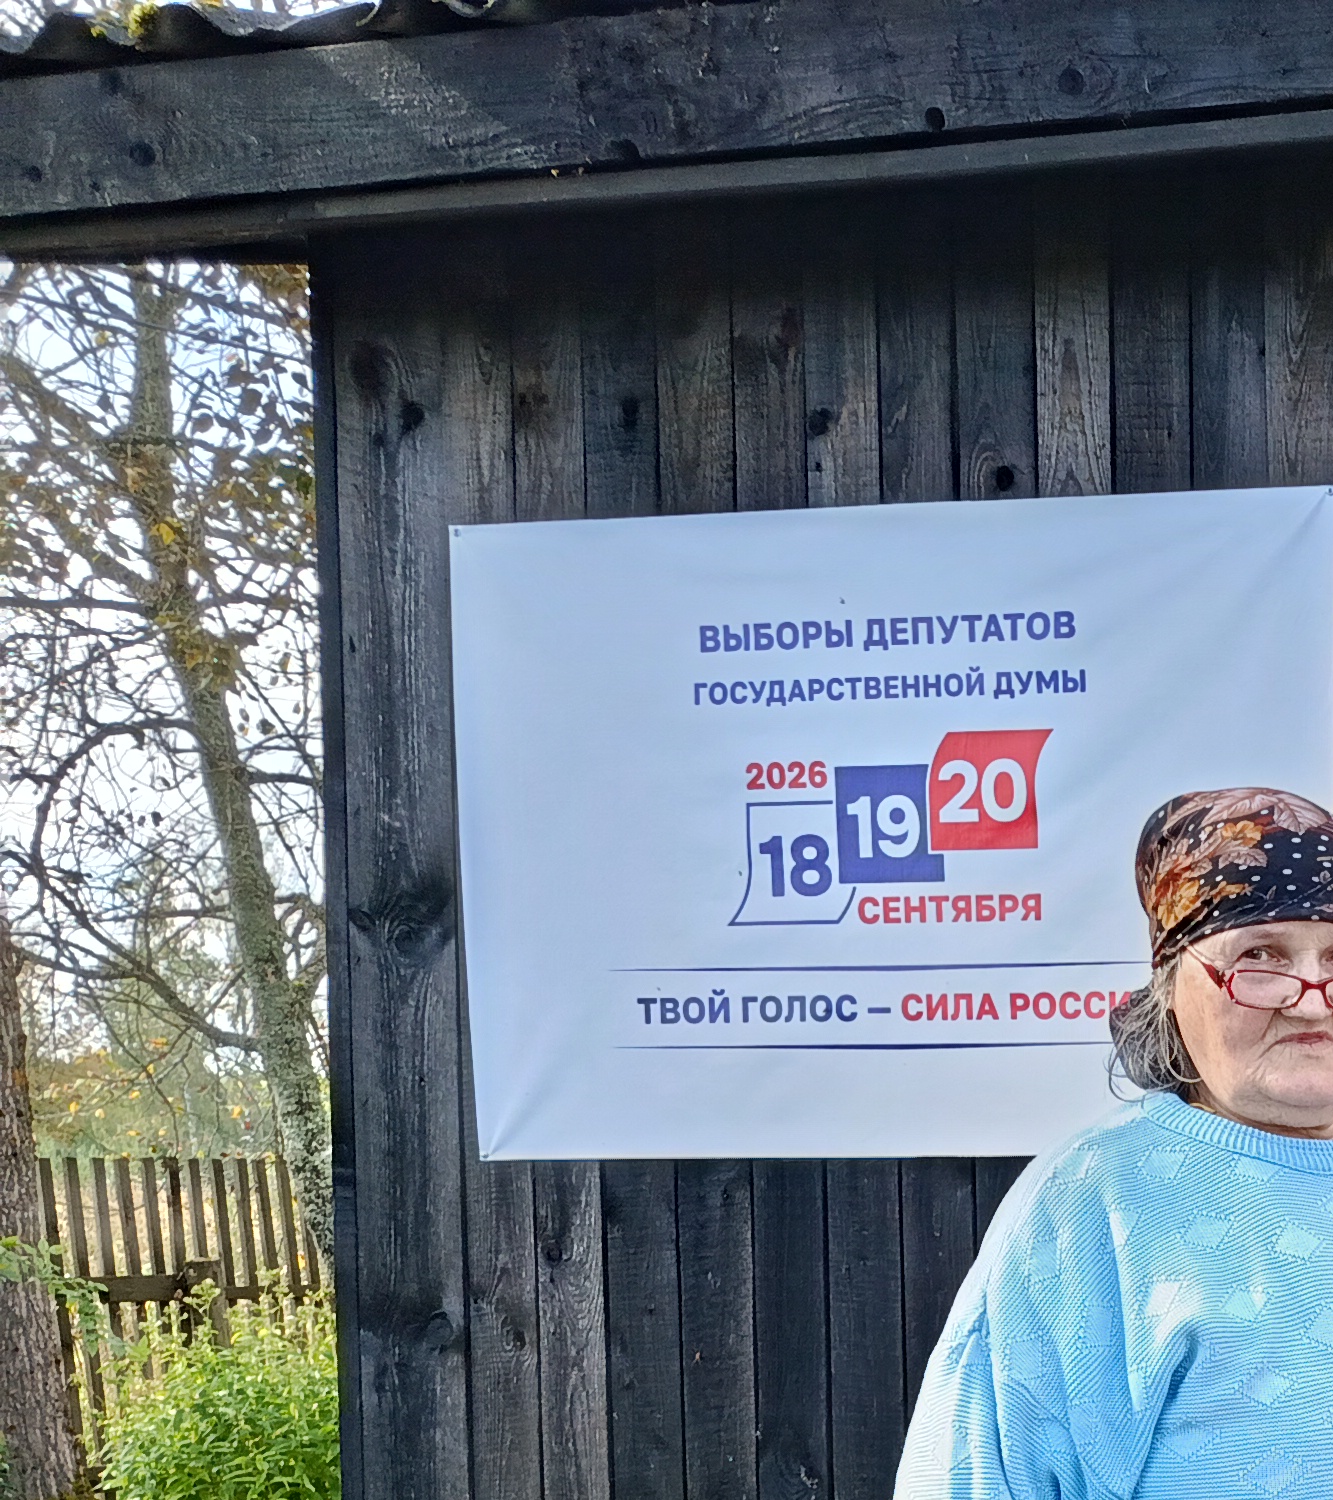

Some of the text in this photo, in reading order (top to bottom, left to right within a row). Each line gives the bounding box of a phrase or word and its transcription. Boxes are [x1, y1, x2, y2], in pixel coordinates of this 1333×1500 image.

[698, 611, 1077, 653] ВЫБОРЫ ДЕПУТАТОВ
[692, 666, 1087, 707] ГОСУДАРСТВЕННОЙ ДУМЫ
[745, 760, 828, 791] 2026
[938, 758, 1027, 823] 20
[846, 794, 921, 860] 19
[758, 834, 832, 899] 18
[857, 893, 1043, 925] СЕНТЯБРЯ
[637, 987, 730, 1026] ТВОЙ
[741, 994, 858, 1025] ГОЛОС
[900, 992, 999, 1022] СИЛА
